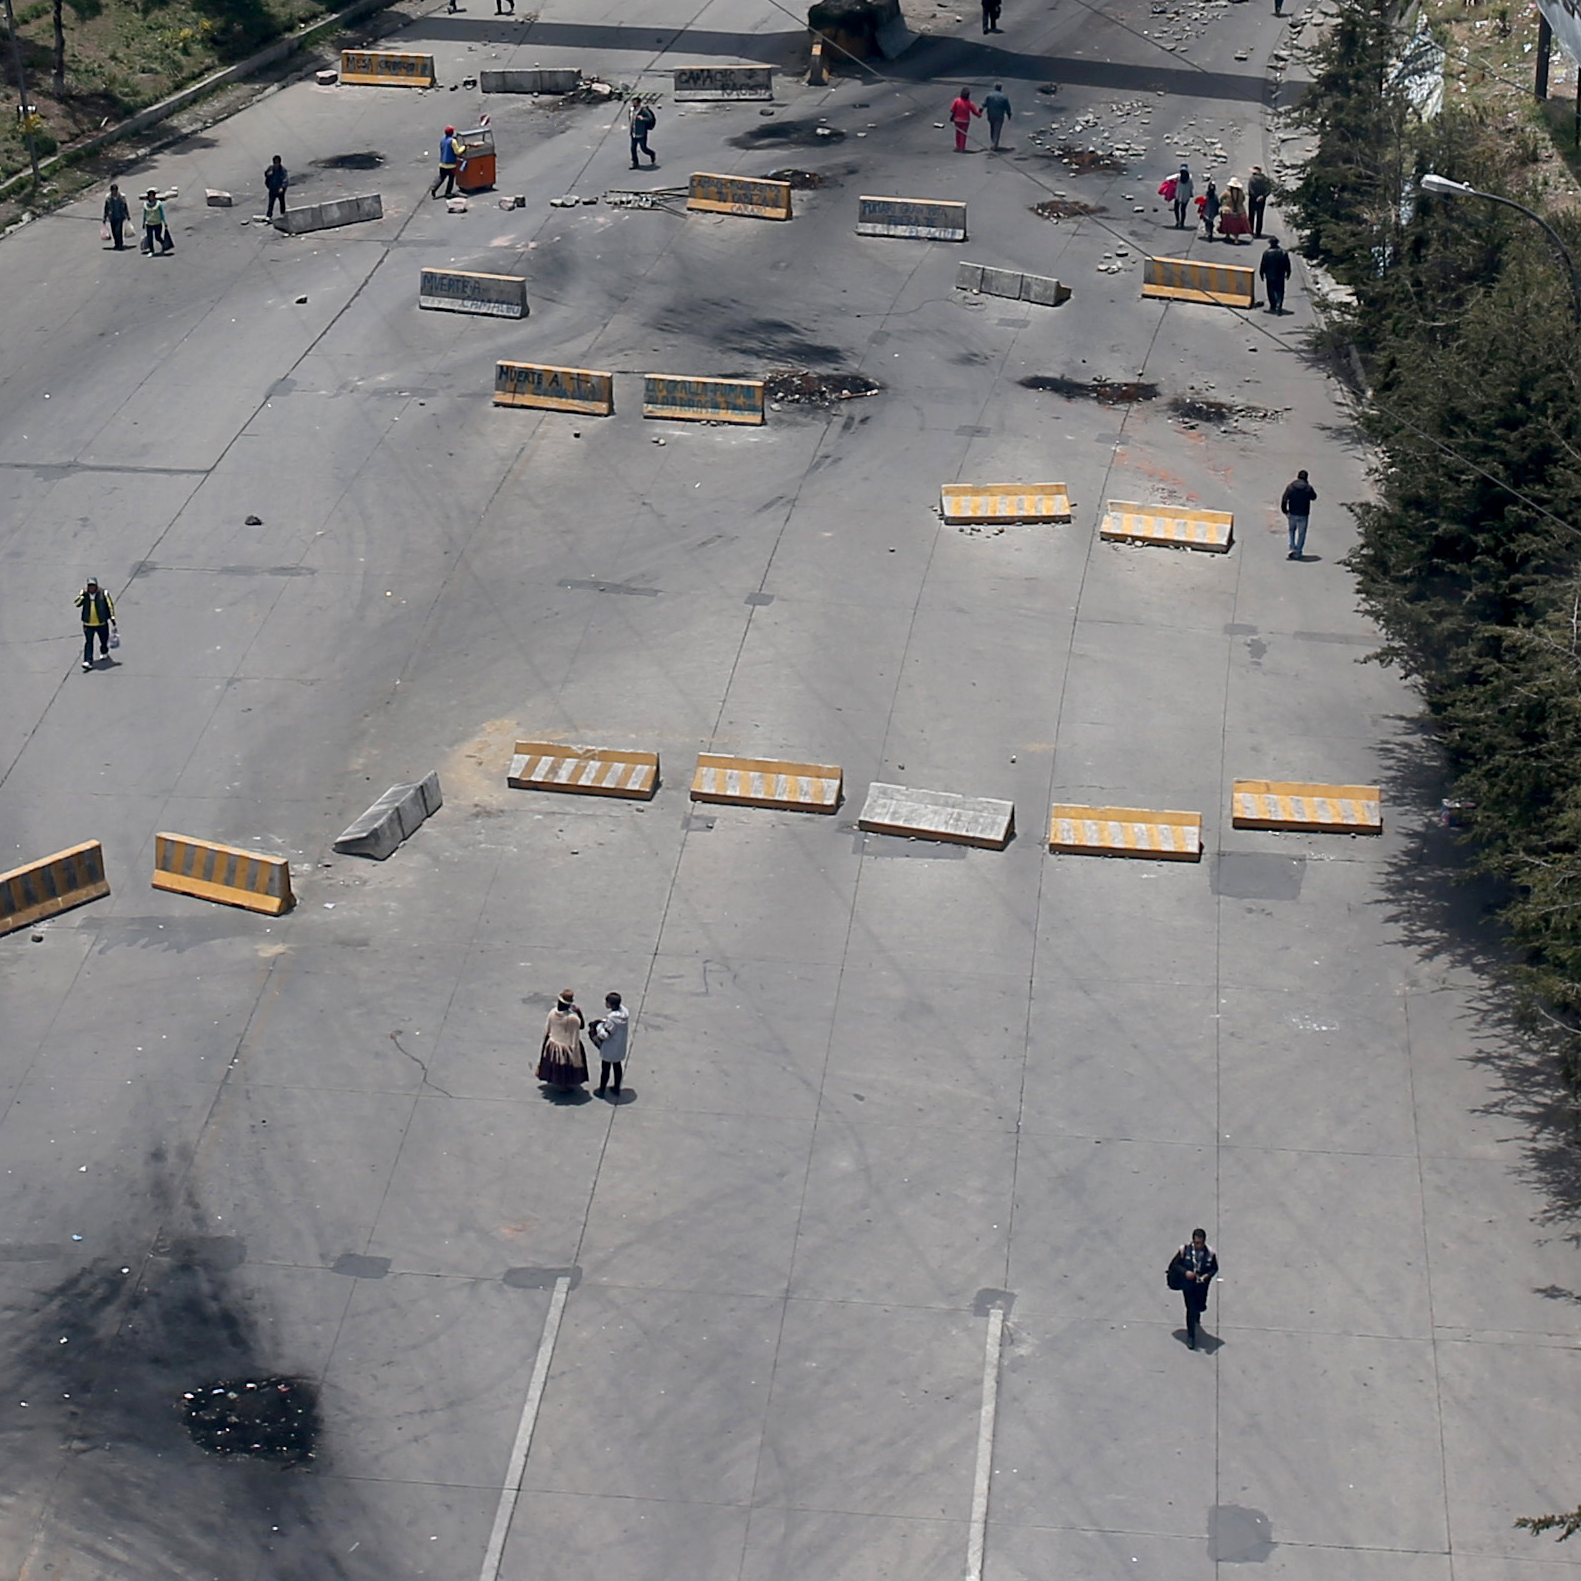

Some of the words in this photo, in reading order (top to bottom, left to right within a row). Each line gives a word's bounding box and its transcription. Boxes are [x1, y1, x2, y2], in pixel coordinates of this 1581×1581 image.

[423, 274, 468, 293] MUERTE
[499, 366, 543, 384] MUERTE
[548, 374, 559, 387] A
